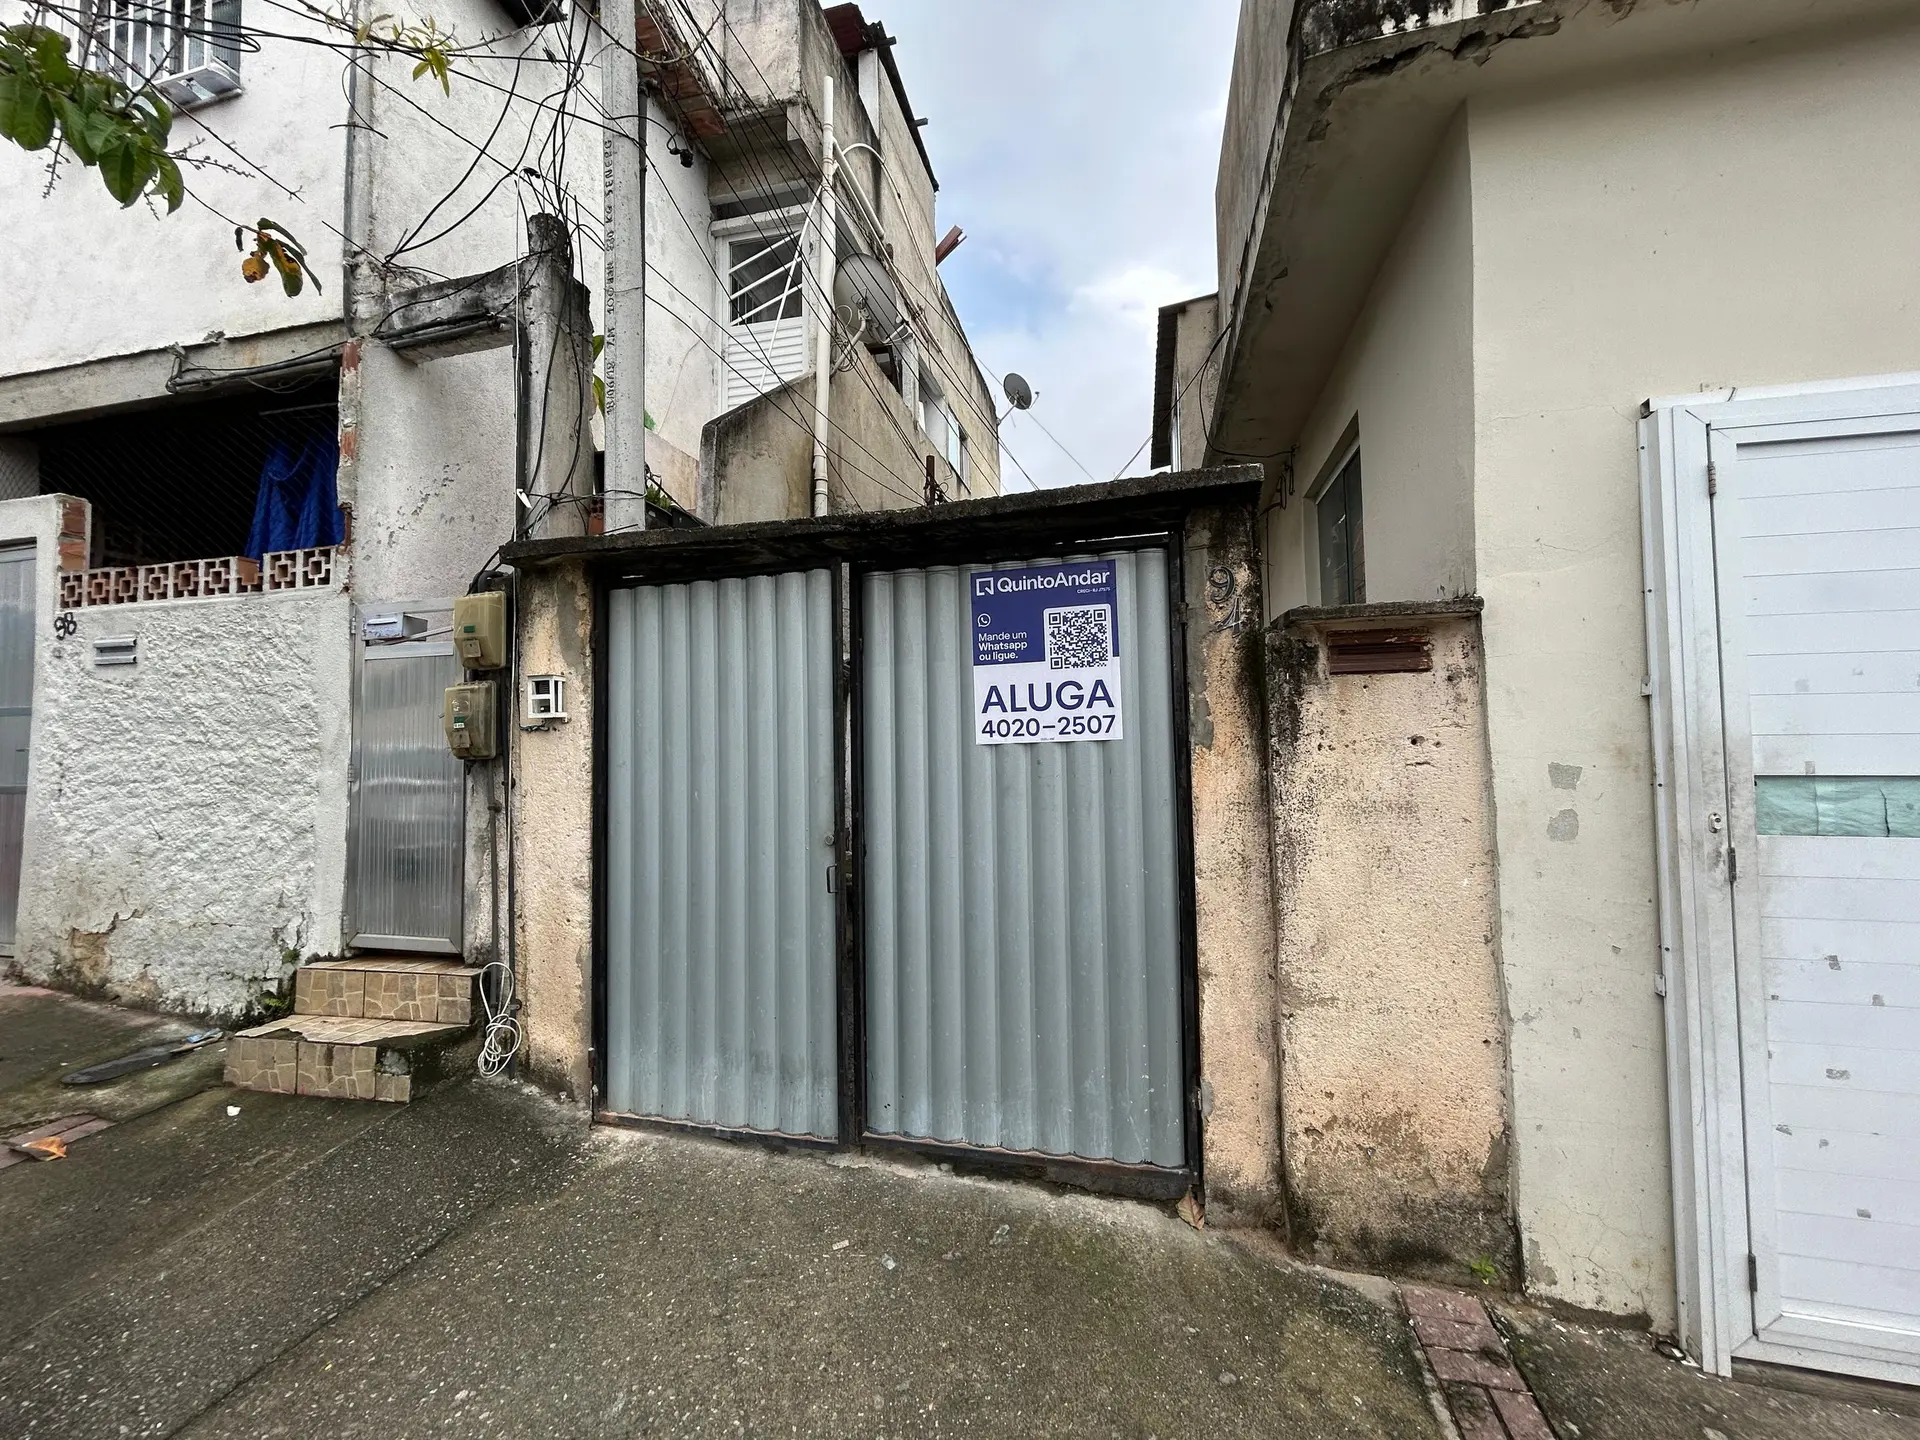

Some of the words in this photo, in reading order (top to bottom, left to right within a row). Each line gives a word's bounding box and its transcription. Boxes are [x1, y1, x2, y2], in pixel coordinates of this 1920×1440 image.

[997, 570, 1110, 593] QuintoAndar
[54, 612, 77, 640] 98
[978, 632, 1010, 642] Mande
[1012, 632, 1027, 640] um
[979, 641, 1028, 652] Whatsapp
[993, 651, 1019, 662] ligue.
[981, 679, 1115, 714] ALUGA
[981, 715, 1116, 738] 4020-2507
